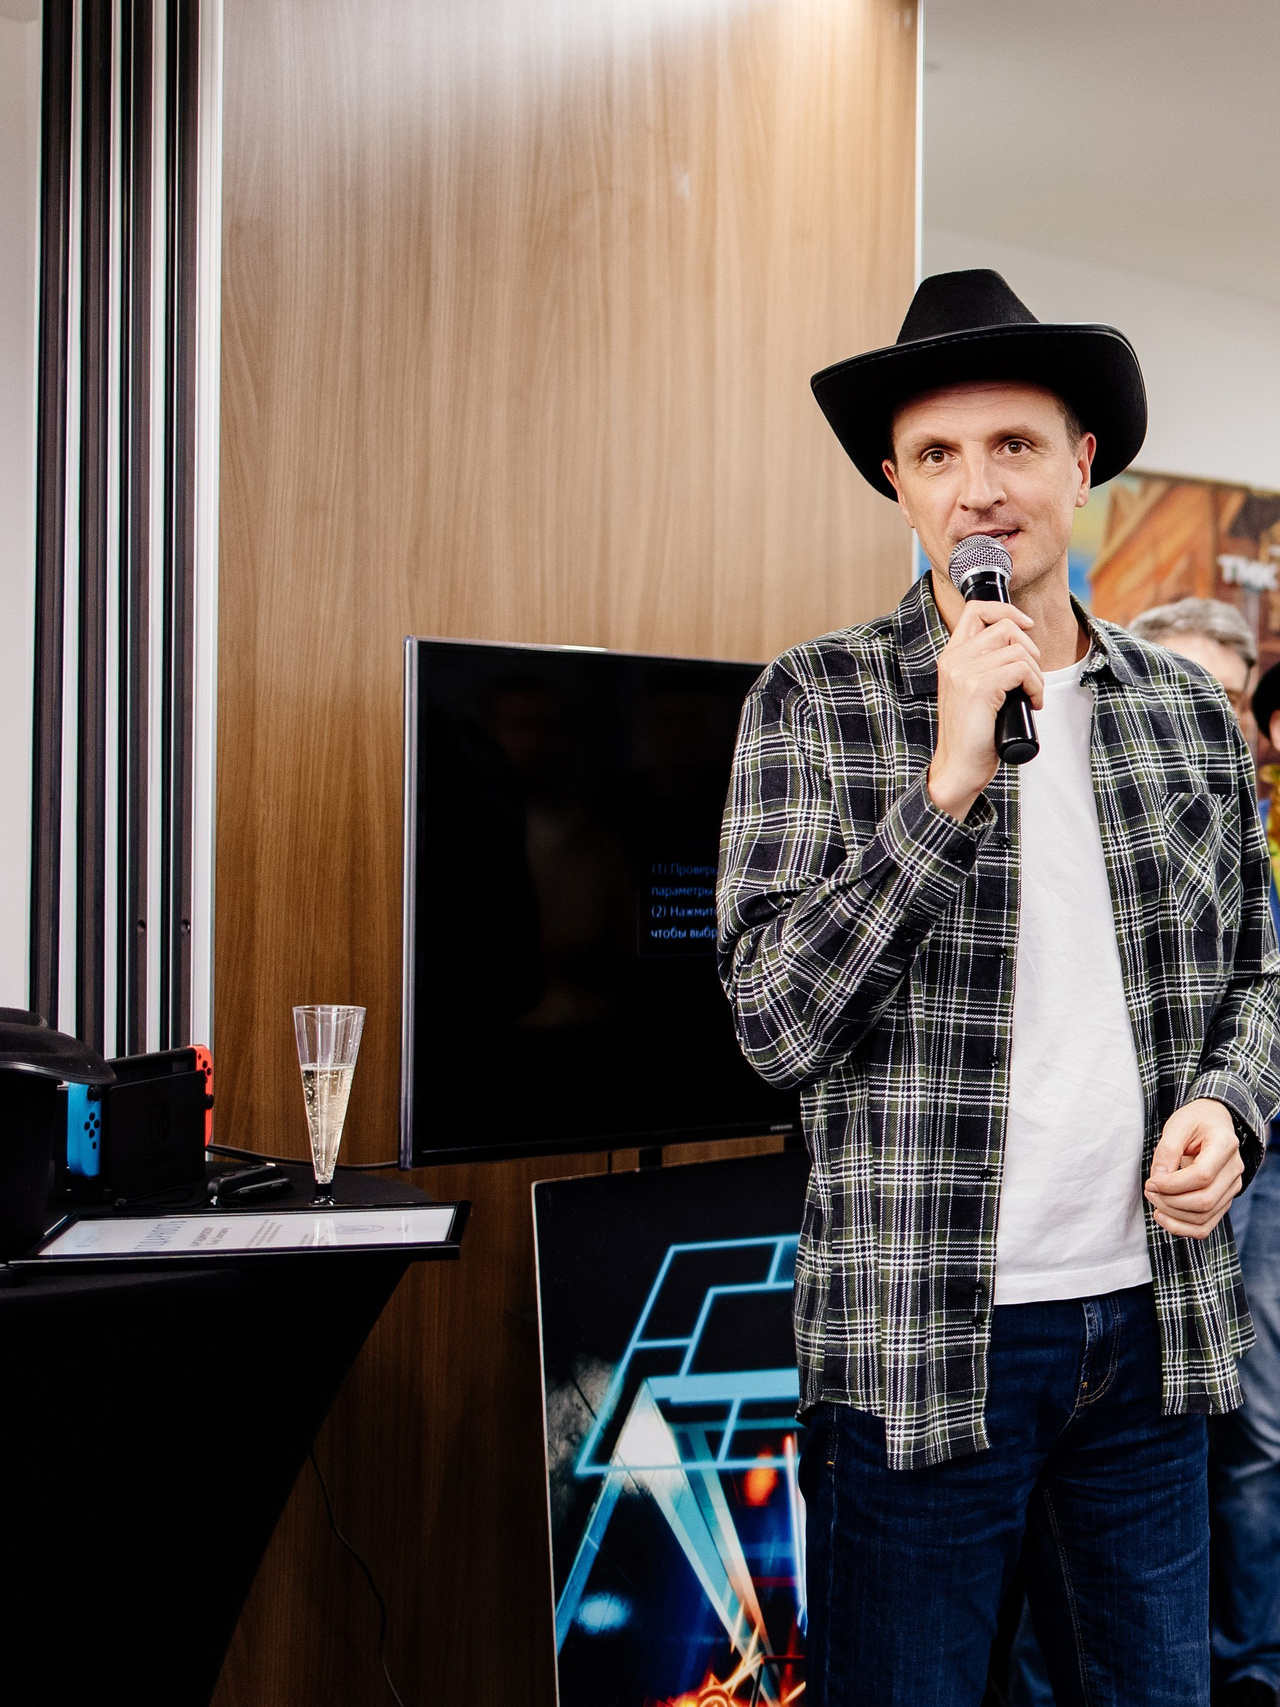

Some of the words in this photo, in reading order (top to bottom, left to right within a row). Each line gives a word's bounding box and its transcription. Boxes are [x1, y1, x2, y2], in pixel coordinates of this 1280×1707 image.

[651, 863, 668, 876] (1)
[651, 886, 714, 899] параметры
[651, 905, 668, 918] (2)
[650, 925, 687, 939] чтобы
